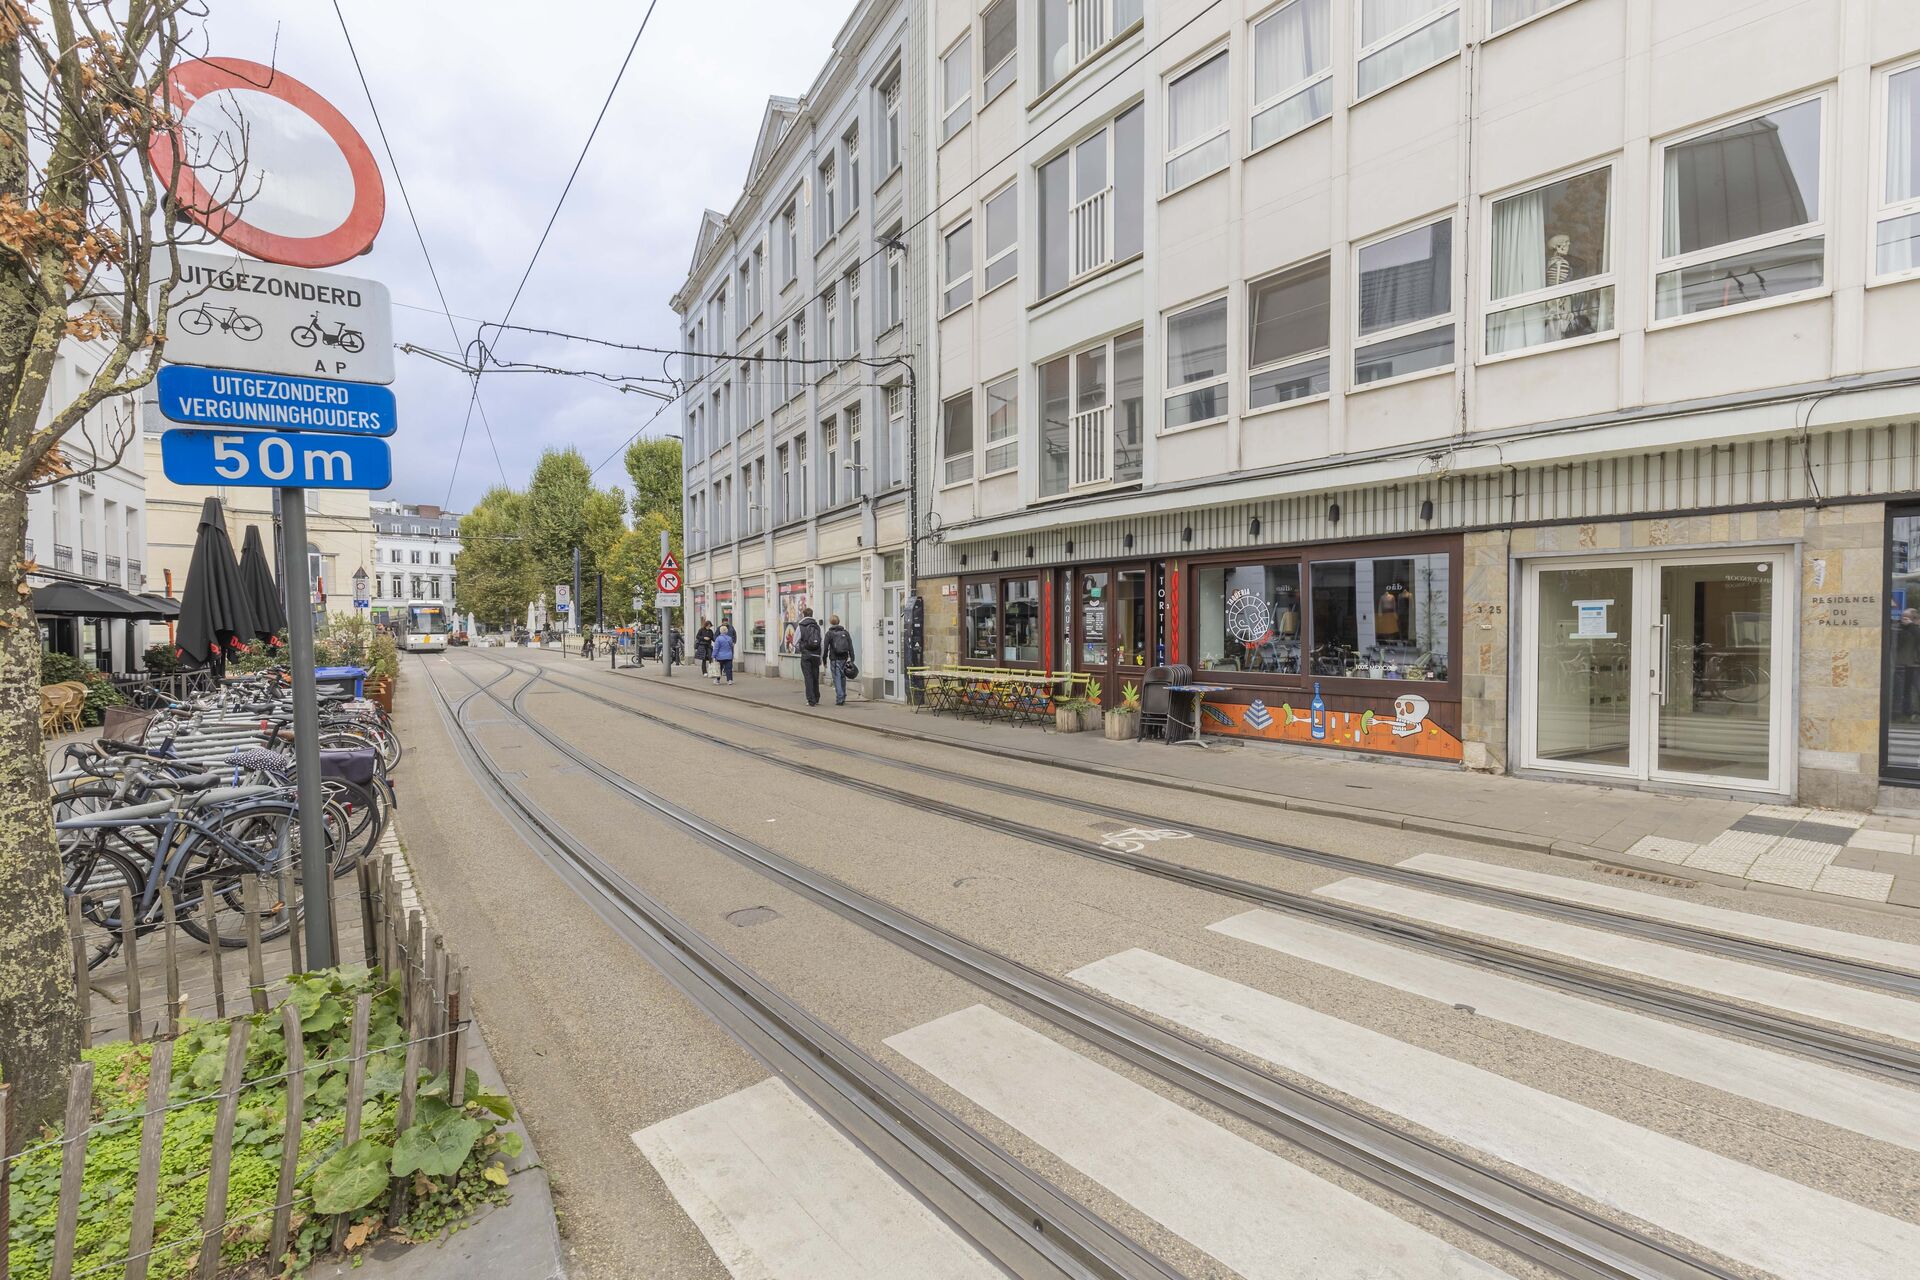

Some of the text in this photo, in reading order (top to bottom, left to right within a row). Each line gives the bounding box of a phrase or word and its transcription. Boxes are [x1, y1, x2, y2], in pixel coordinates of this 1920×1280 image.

[179, 265, 362, 308] UITGEZONDERD
[314, 359, 347, 374] A P
[212, 375, 349, 405] UITGEZONDERD
[178, 397, 381, 430] VERGUNNINGHOUDERS
[213, 435, 353, 481] 50 m
[1226, 588, 1251, 606] TAQUERIA
[1812, 596, 1876, 604] RESIDENCE
